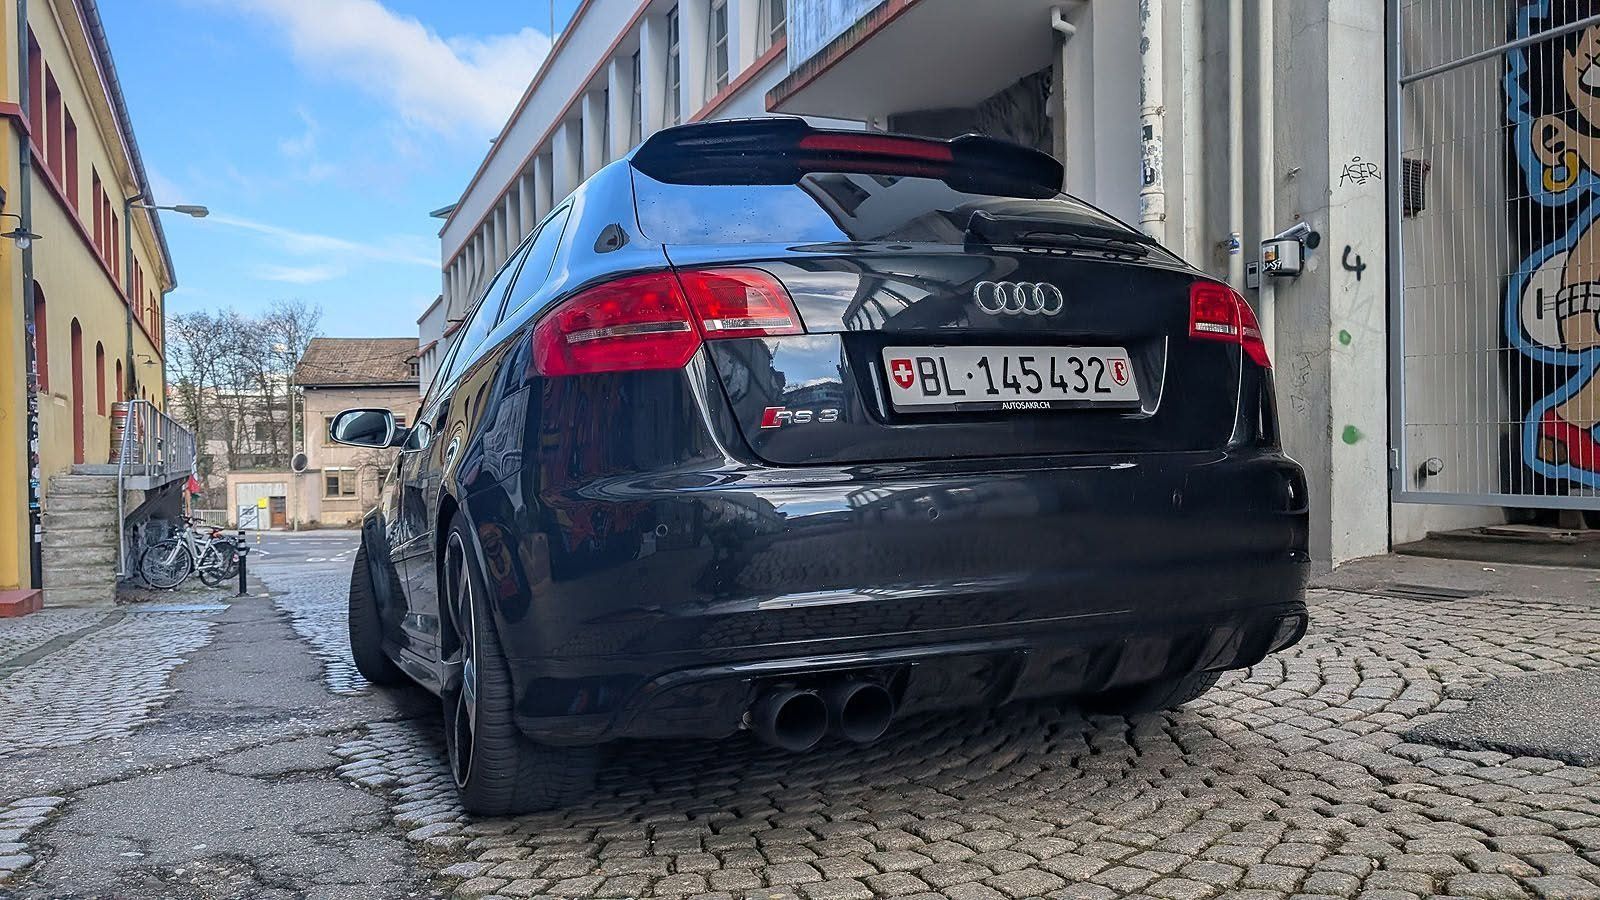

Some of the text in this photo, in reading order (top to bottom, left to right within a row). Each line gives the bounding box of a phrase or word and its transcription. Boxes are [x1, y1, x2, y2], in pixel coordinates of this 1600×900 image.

[1342, 245, 1366, 281] 4
[1002, 401, 1051, 410] AUTOSAKR.CH
[772, 408, 839, 425] RS 3
